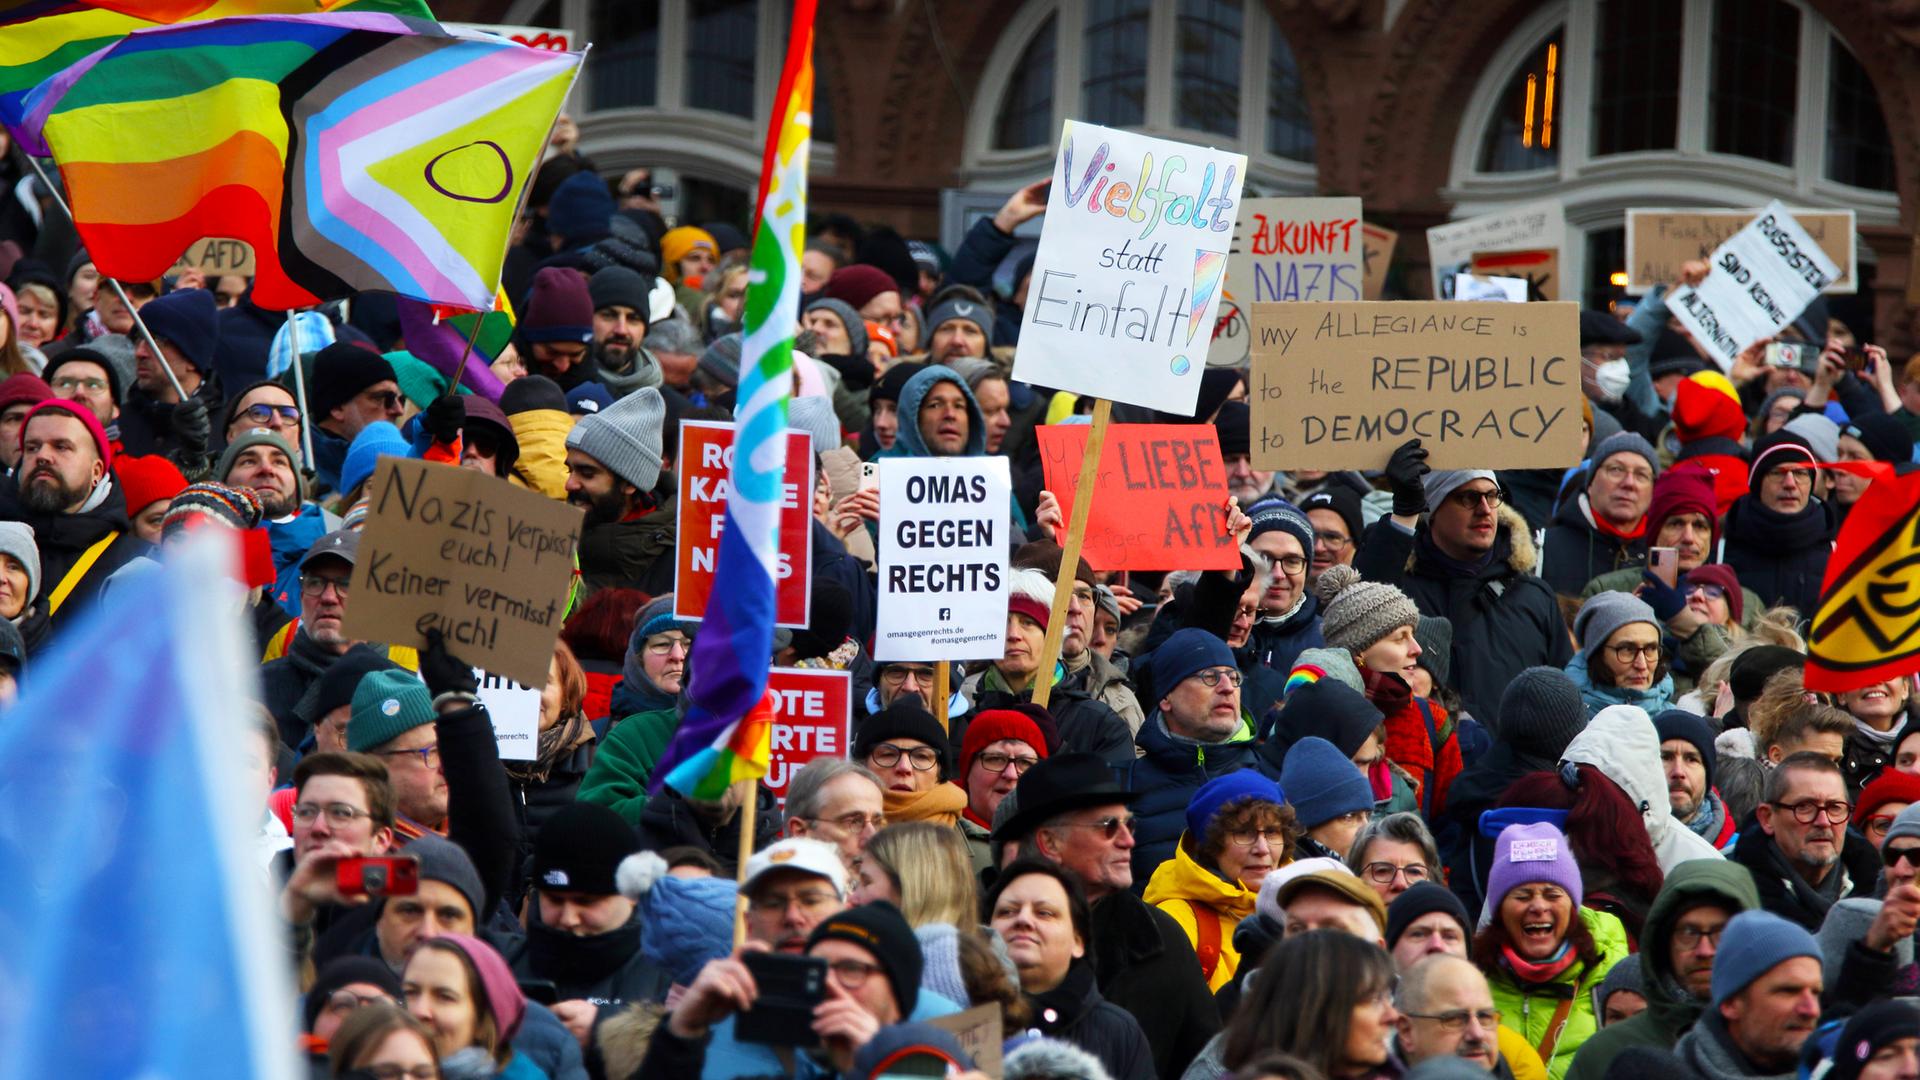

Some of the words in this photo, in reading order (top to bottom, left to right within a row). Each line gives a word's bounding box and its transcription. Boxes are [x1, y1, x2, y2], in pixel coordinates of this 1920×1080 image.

[1064, 135, 1237, 240] Vielfalt
[200, 240, 247, 269] AFD
[1251, 213, 1359, 255] ZUKUNFT
[1099, 239, 1166, 273] statt
[1254, 261, 1360, 301] NAZIS
[1032, 249, 1227, 376] Einfalt!
[1261, 327, 1298, 356] my
[1315, 311, 1496, 341] ALLEGIANCE
[1512, 324, 1528, 337] is
[1260, 372, 1283, 402] to
[1308, 368, 1346, 395] the
[1371, 355, 1567, 392] REPUBLIC
[1260, 426, 1285, 454] to
[1300, 405, 1566, 445] DEMOCRACY
[1118, 438, 1223, 491] LIEBE
[377, 464, 496, 536] Nazis
[906, 475, 986, 504] OMAS
[897, 519, 993, 549] GEGEN
[1162, 502, 1234, 549] AfD
[441, 539, 511, 572] euch!
[366, 550, 450, 596] Keiner
[465, 583, 556, 627] vermisst
[888, 563, 1000, 593] RECHTS
[416, 612, 498, 650] euch!
[887, 627, 964, 639] omasgegenrechts.de
[931, 632, 998, 645] #omasgegenrechts
